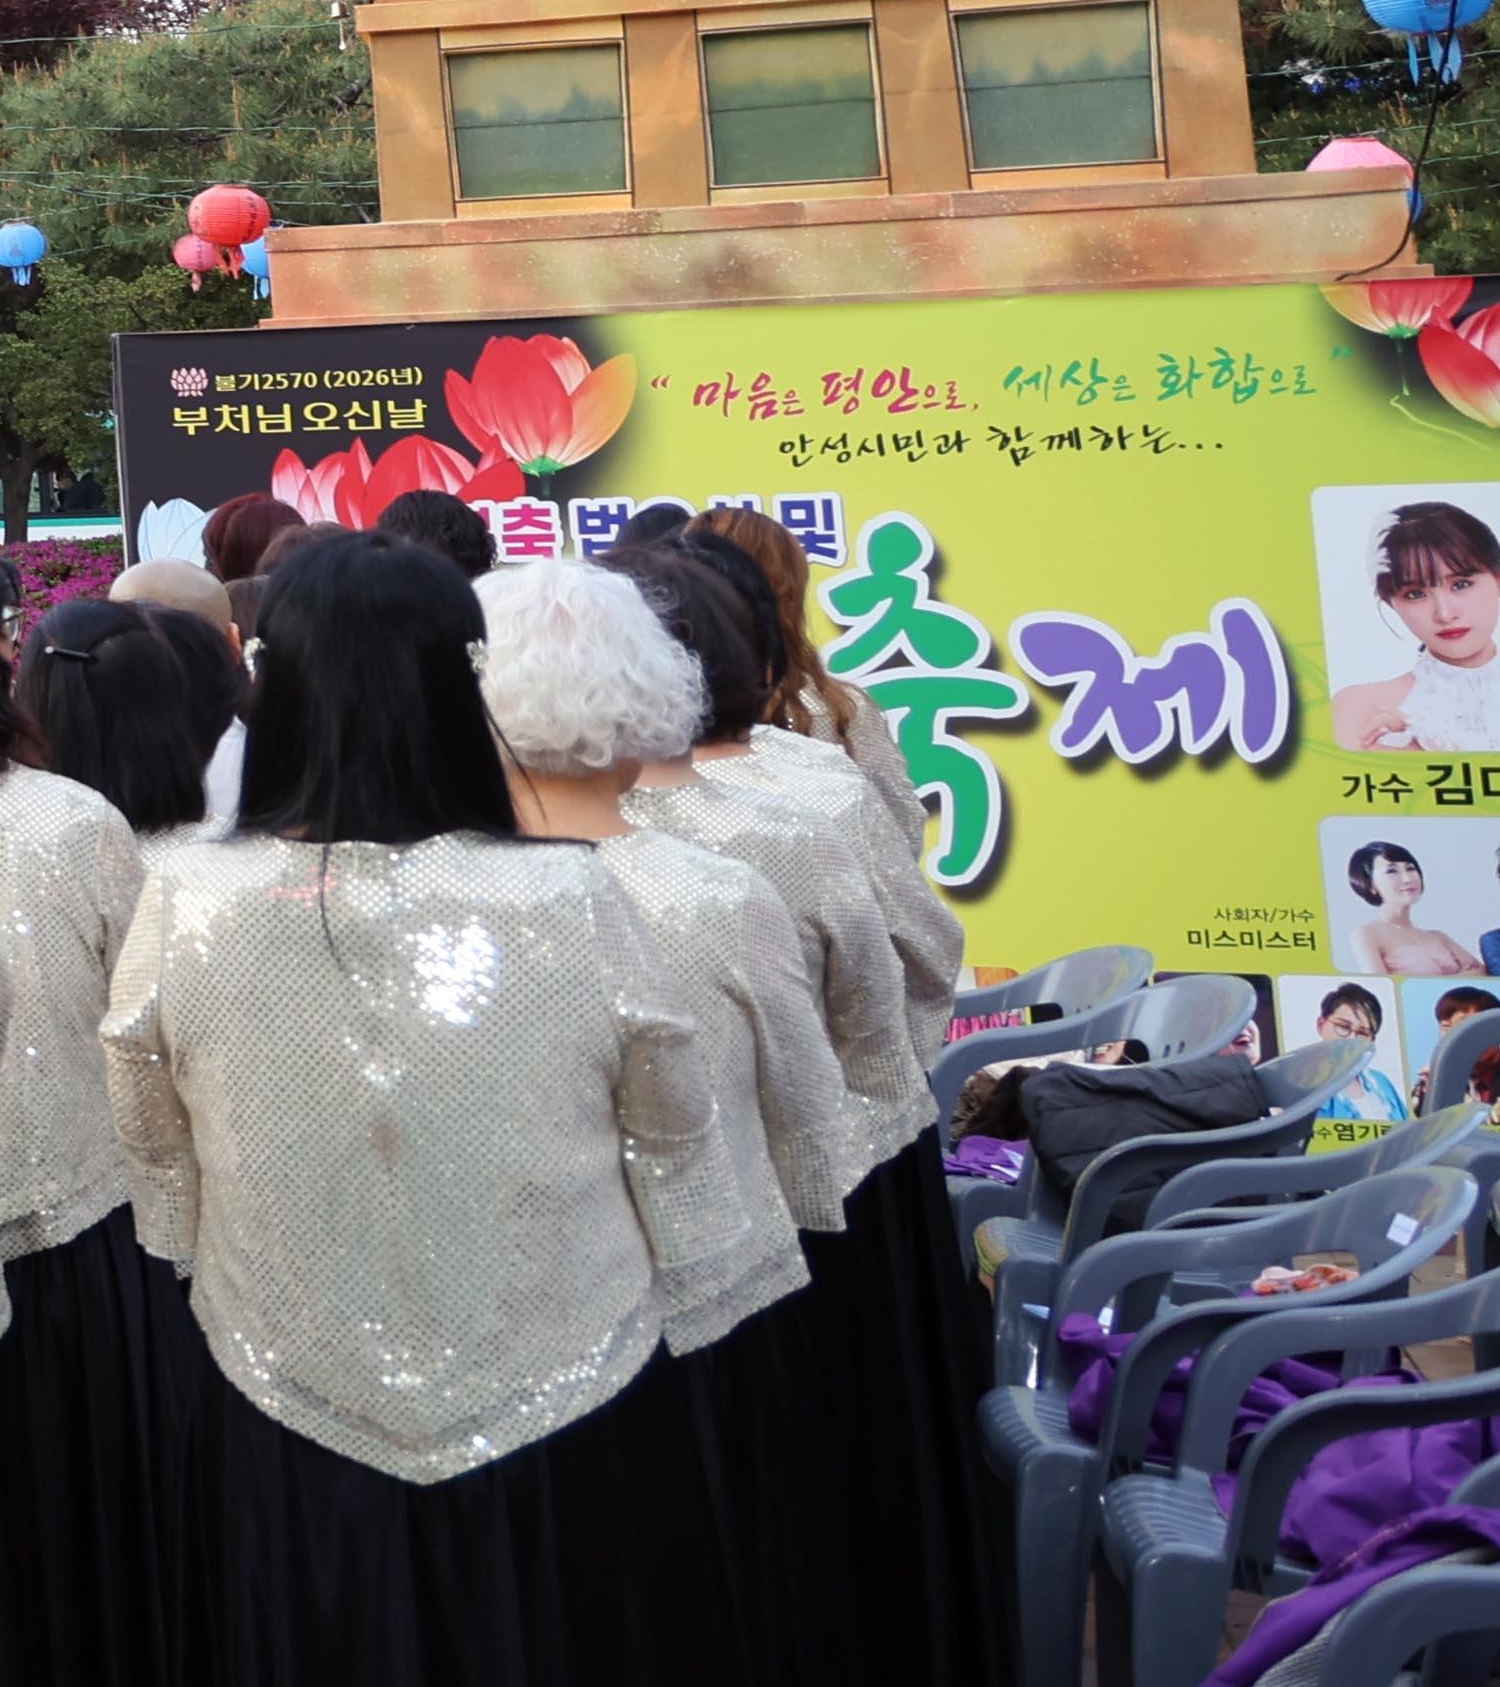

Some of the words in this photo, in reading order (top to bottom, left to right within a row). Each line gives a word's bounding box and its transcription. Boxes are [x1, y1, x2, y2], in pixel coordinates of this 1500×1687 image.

[215, 370, 318, 392] 불기2570
[323, 366, 424, 390] (2026년)
[693, 371, 805, 421] 마음은
[820, 366, 979, 415] 평안으로,
[1003, 357, 1137, 407] 세상은
[1156, 346, 1317, 404] 화합으로
[172, 403, 293, 436] 부처님
[302, 398, 428, 432] 오신날
[778, 428, 972, 468] 안성시민과
[1341, 773, 1414, 803] 가수
[1213, 907, 1316, 924] 사회자/가수
[1187, 929, 1317, 951] 미스미스터
